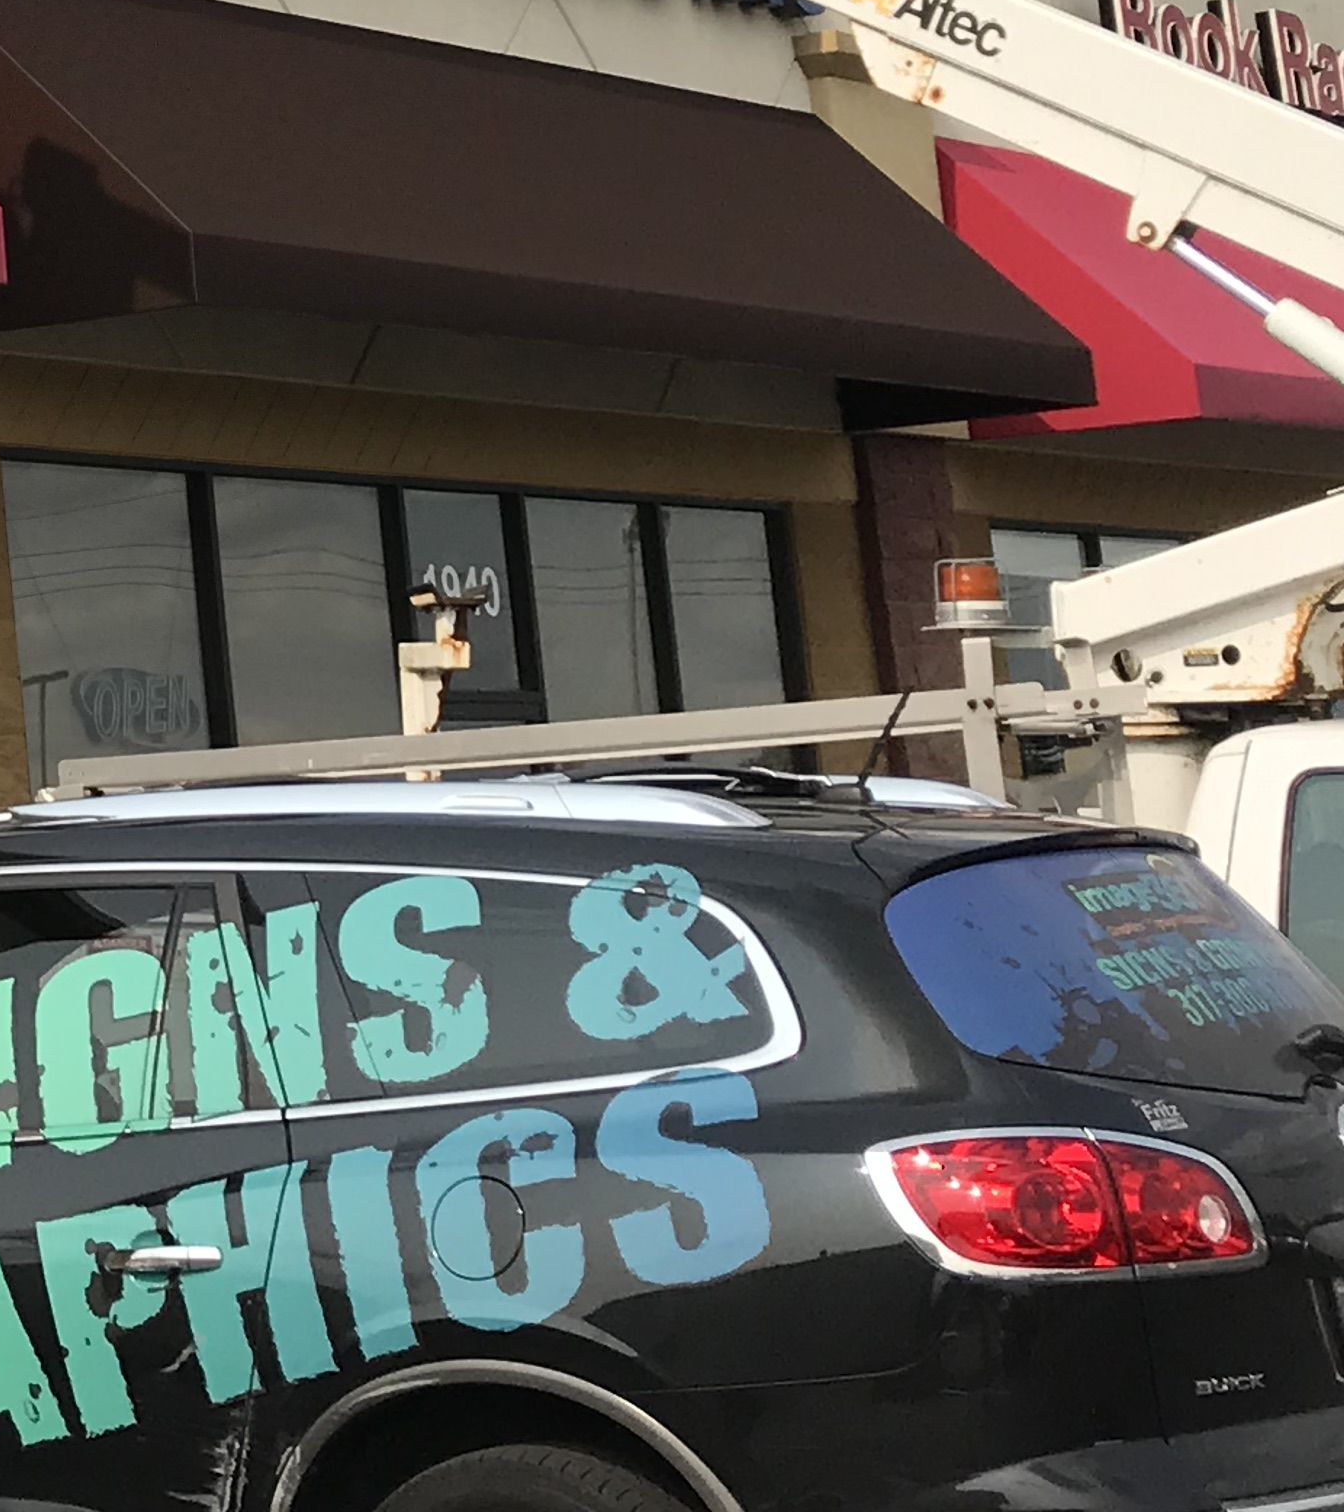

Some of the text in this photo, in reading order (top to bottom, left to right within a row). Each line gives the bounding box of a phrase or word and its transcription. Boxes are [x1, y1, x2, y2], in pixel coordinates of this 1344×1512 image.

[1256, 8, 1344, 116] Ra
[94, 674, 193, 739] OPEN
[565, 863, 748, 1040] &
[1195, 1373, 1266, 1396] BUICK
